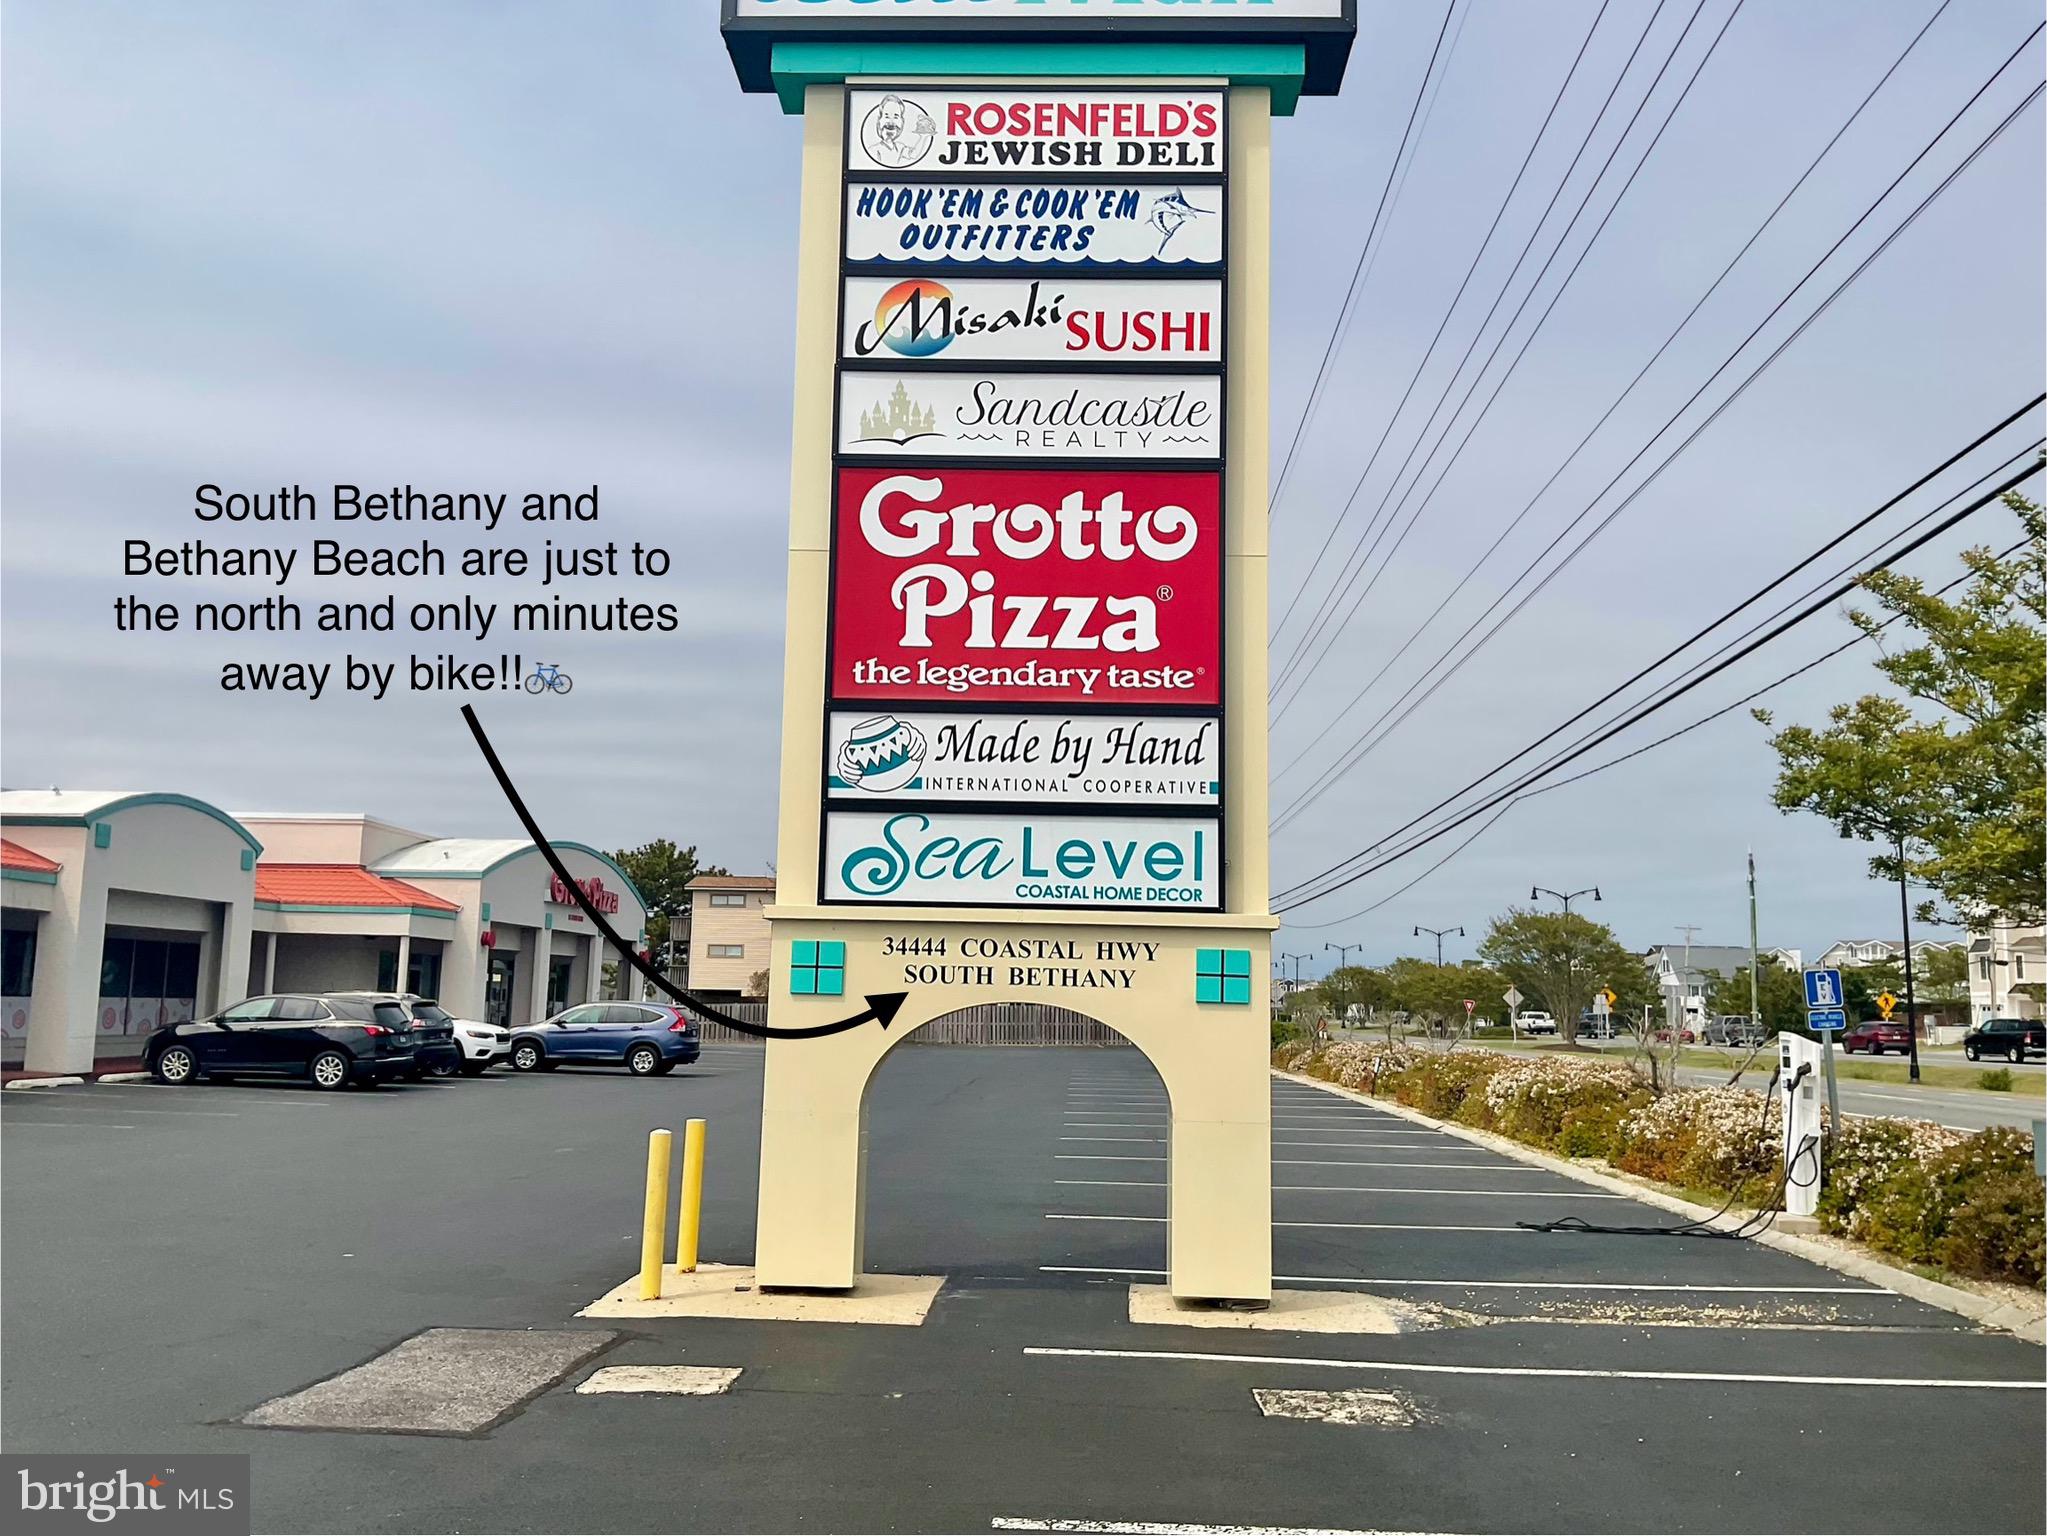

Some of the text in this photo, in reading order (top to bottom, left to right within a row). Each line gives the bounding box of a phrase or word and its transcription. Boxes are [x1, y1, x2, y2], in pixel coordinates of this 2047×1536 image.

[947, 101, 1217, 137] ROSENFELD'S
[939, 141, 1216, 167] JEWISH DELI
[856, 187, 932, 218] HOOK
[989, 188, 1009, 218] &
[1015, 188, 1089, 220] COOK
[900, 223, 1095, 251] OUTFITTERS
[855, 282, 1211, 355] Misaki SUSHI
[957, 381, 1212, 427] Sandcastle
[1017, 431, 1152, 448] REALTY
[860, 475, 1198, 562] Grotto
[852, 657, 911, 684] the
[917, 658, 1102, 695] legendary
[934, 719, 1212, 778] Made by Hand
[926, 777, 1207, 795] INTERNATIONAL COOPERATIVE
[841, 813, 1203, 895] Sea Level
[1016, 883, 1203, 903] COASTAL HOME DECOR
[881, 937, 1161, 962] 34444 COASTAL HWY
[903, 963, 1137, 989] SOUTH BETHANY
